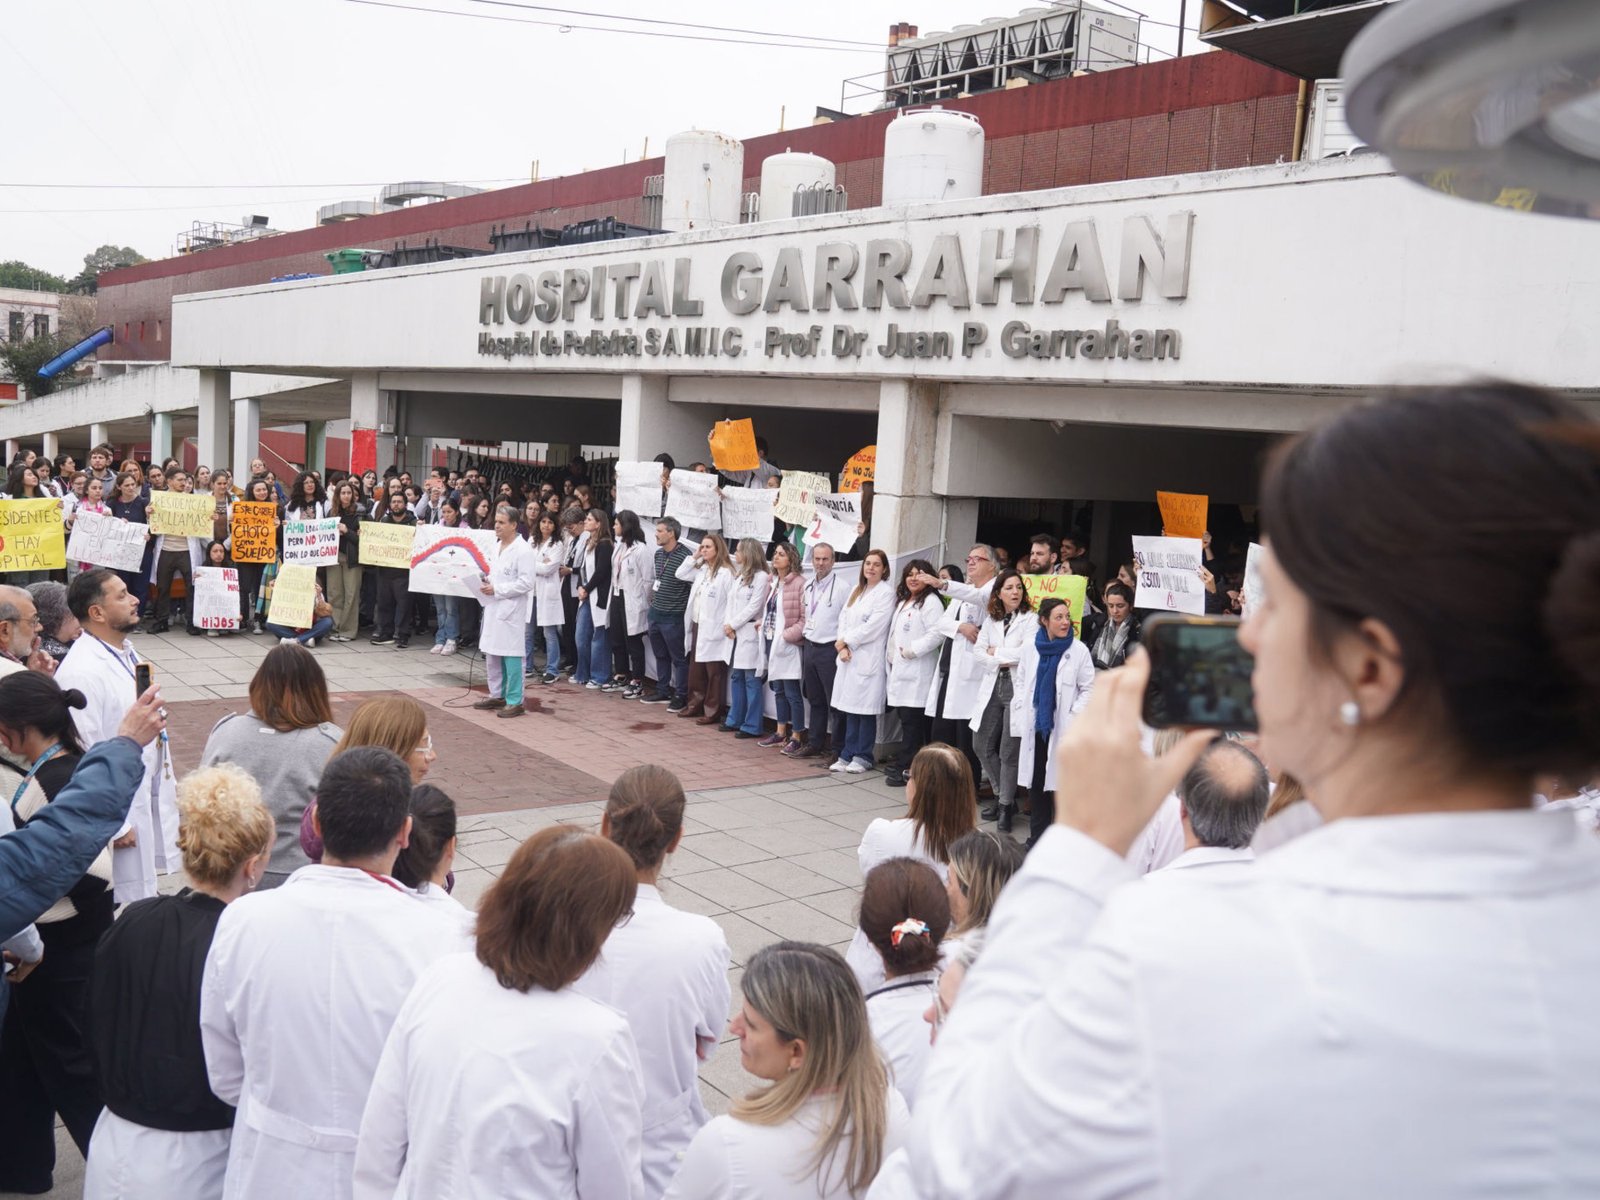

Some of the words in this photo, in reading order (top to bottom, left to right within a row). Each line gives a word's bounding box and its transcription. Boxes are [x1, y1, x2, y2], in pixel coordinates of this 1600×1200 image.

[479, 256, 705, 326] HOSPITAL
[719, 210, 1197, 317] GARRAHAN
[478, 330, 539, 362] Hospital
[540, 331, 562, 356] de
[877, 323, 954, 358] Juan
[1000, 319, 1183, 361] Garrahan
[852, 466, 863, 476] NO
[800, 490, 809, 505] NO
[152, 512, 164, 523] EN
[167, 511, 207, 527] LLAMAS
[233, 524, 270, 539] CHOTO
[285, 521, 305, 534] AMO
[14, 535, 41, 550] HAY
[287, 537, 304, 547] PERO
[305, 534, 317, 546] NO
[318, 532, 336, 543] VIVO
[234, 546, 275, 561] SUELDO
[284, 550, 299, 559] CON
[300, 550, 309, 559] LO
[222, 568, 239, 582] MAL
[1039, 576, 1060, 593] NO
